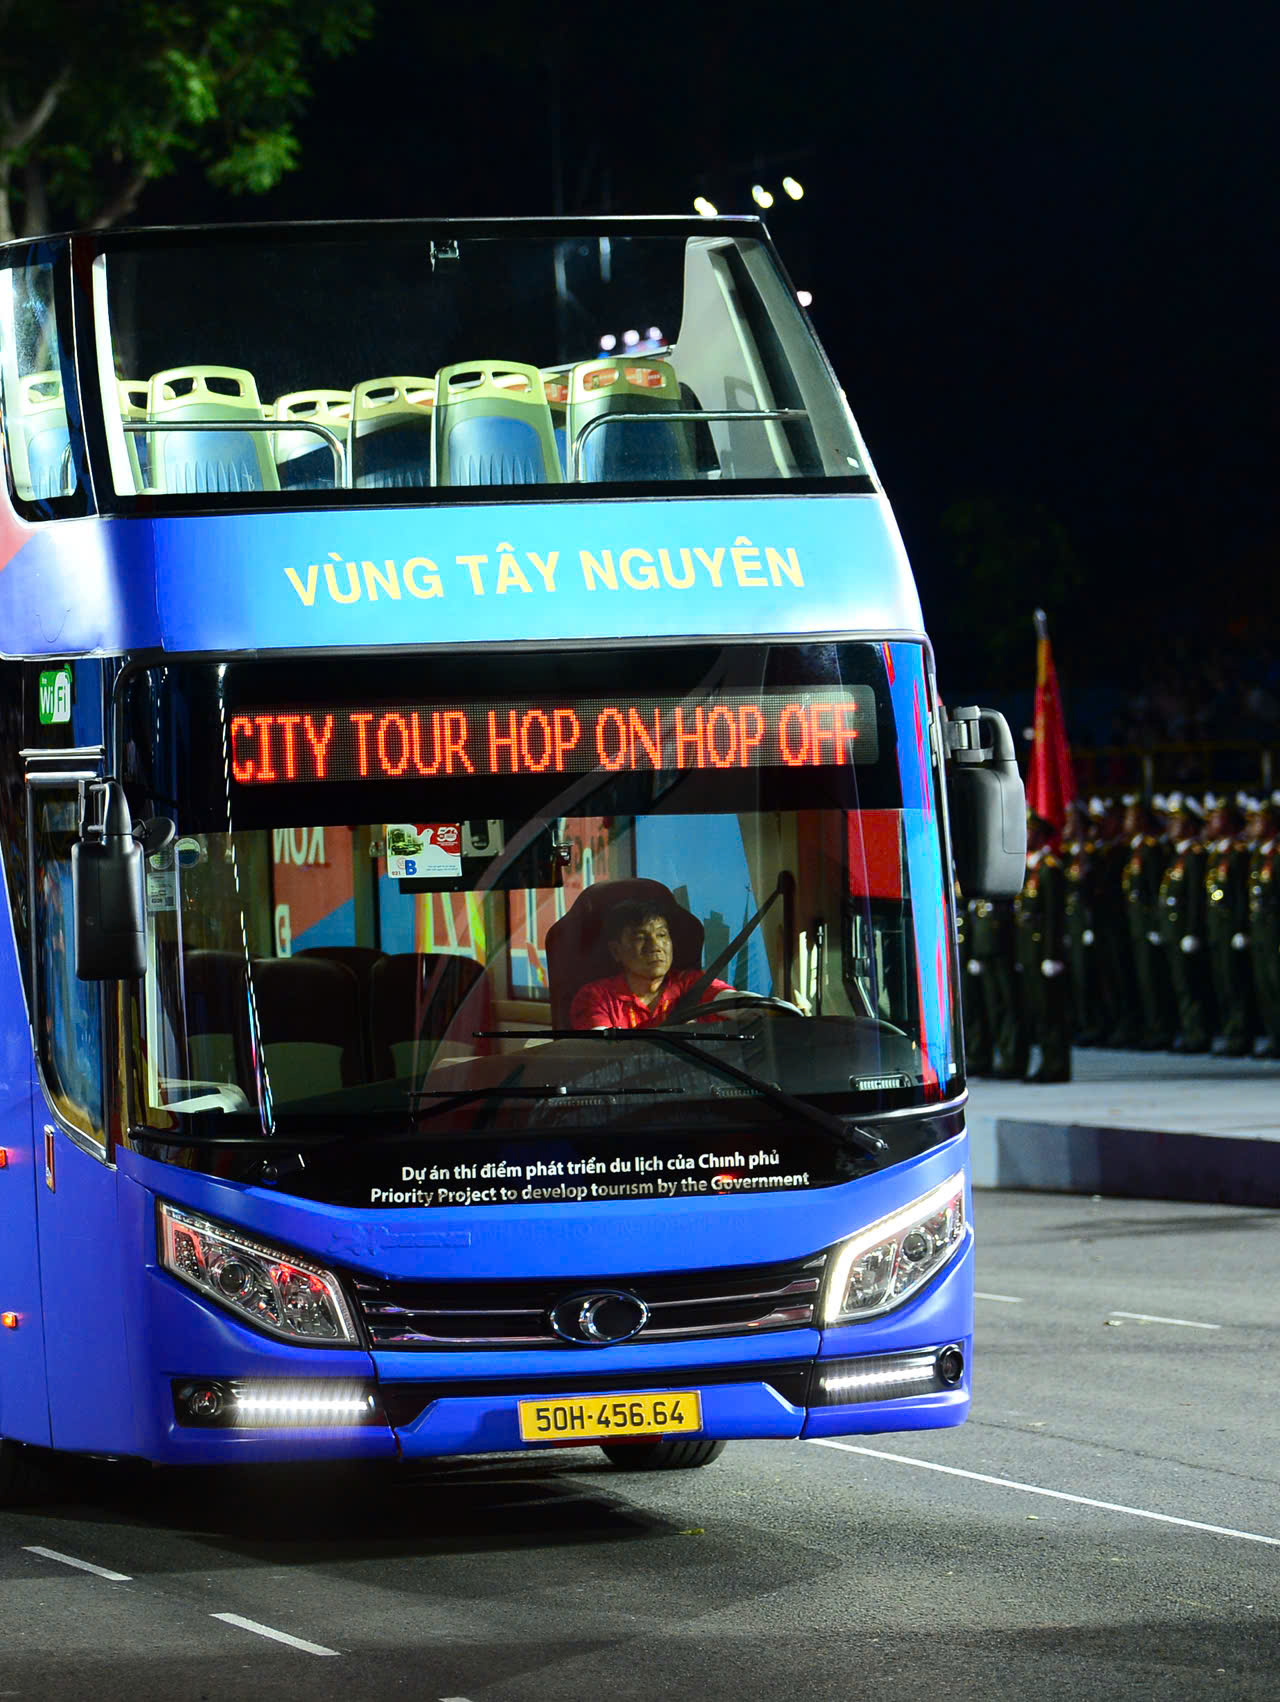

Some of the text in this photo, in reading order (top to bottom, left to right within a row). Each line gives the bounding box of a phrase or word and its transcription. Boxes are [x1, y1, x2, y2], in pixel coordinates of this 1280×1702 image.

[285, 536, 805, 607] VÙNG TÂY NGUYÊN
[231, 702, 858, 782] CITY TOUR HOP ON HOP OFF
[404, 859, 417, 876] B
[401, 1165, 428, 1185] Dự
[429, 1165, 450, 1180] án
[453, 1163, 477, 1179] thí
[480, 1160, 522, 1178] điểm
[525, 1160, 564, 1180] phát
[567, 1156, 606, 1176] triển
[609, 1157, 631, 1173] du
[634, 1156, 664, 1175] lịch
[666, 1153, 695, 1170] của
[748, 1149, 780, 1169] phủ
[371, 1172, 810, 1207] Priority Project to develop tourism by the Government
[536, 1400, 685, 1432] 50H-456.64
